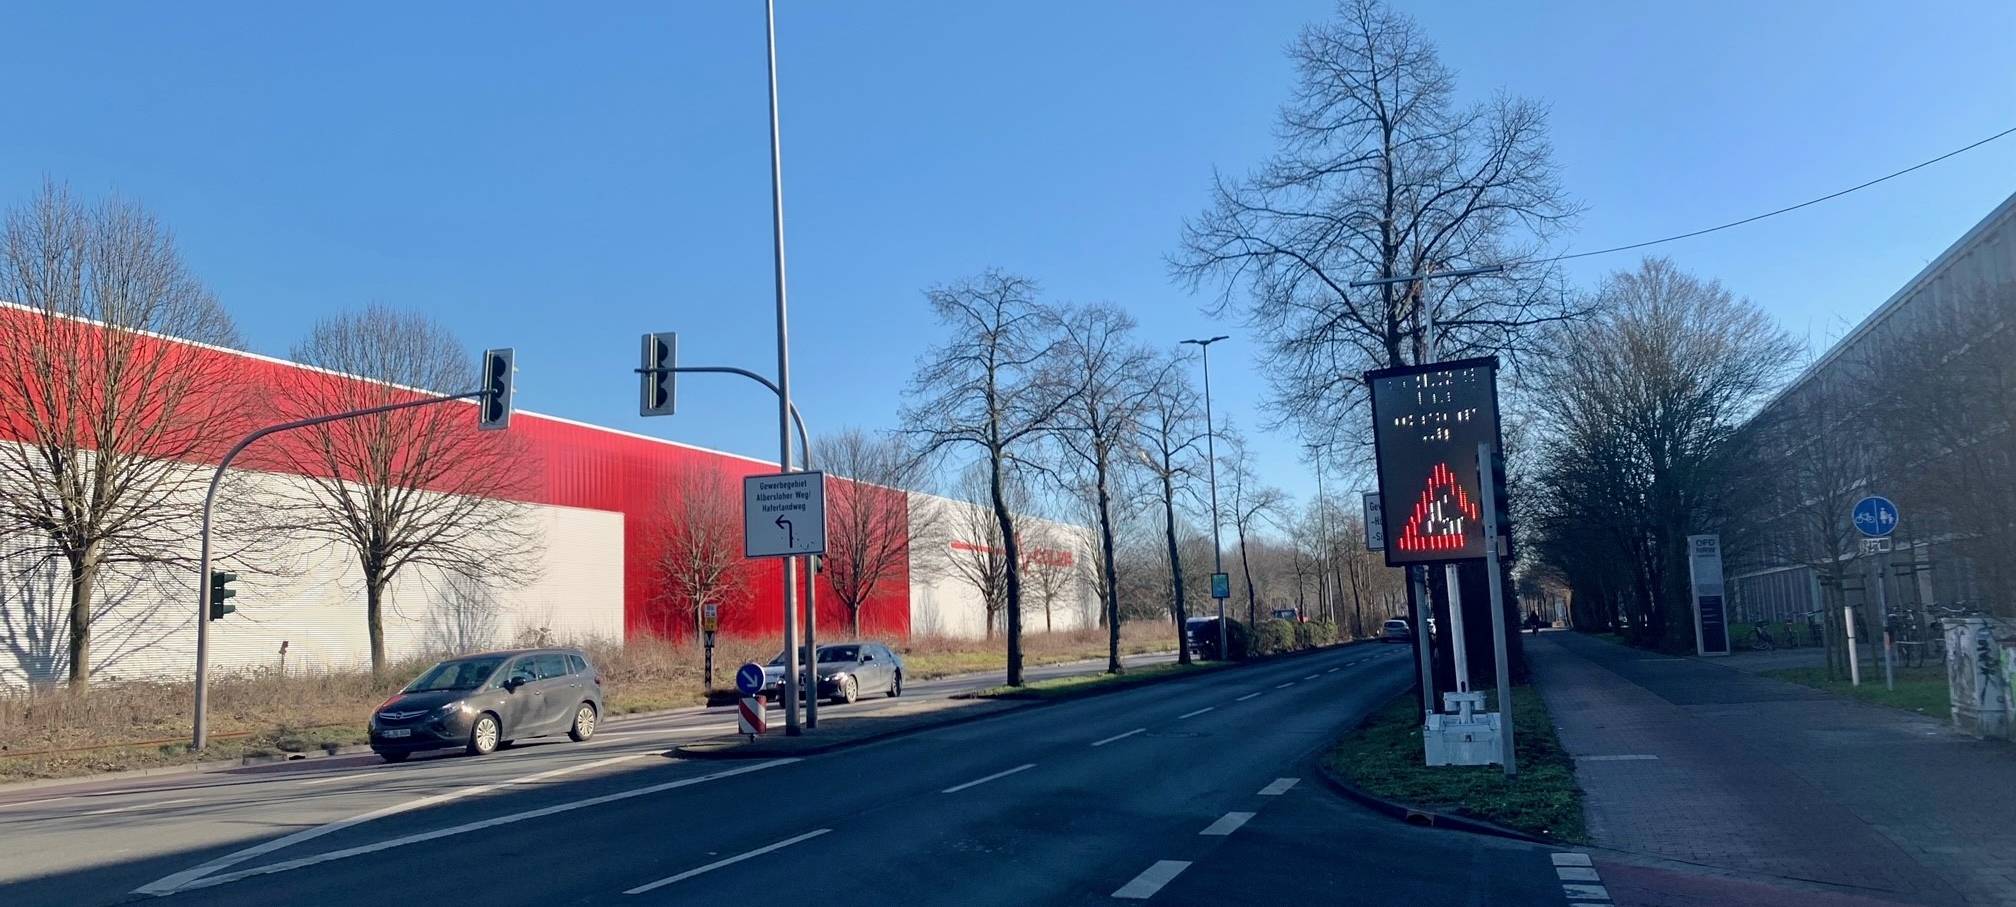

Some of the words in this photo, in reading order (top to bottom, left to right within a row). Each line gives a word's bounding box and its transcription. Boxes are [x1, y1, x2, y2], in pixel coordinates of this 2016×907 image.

[760, 480, 807, 490] Gewerbegebiet
[756, 491, 793, 501] Albersloher
[762, 503, 806, 512] Haferlandweg
